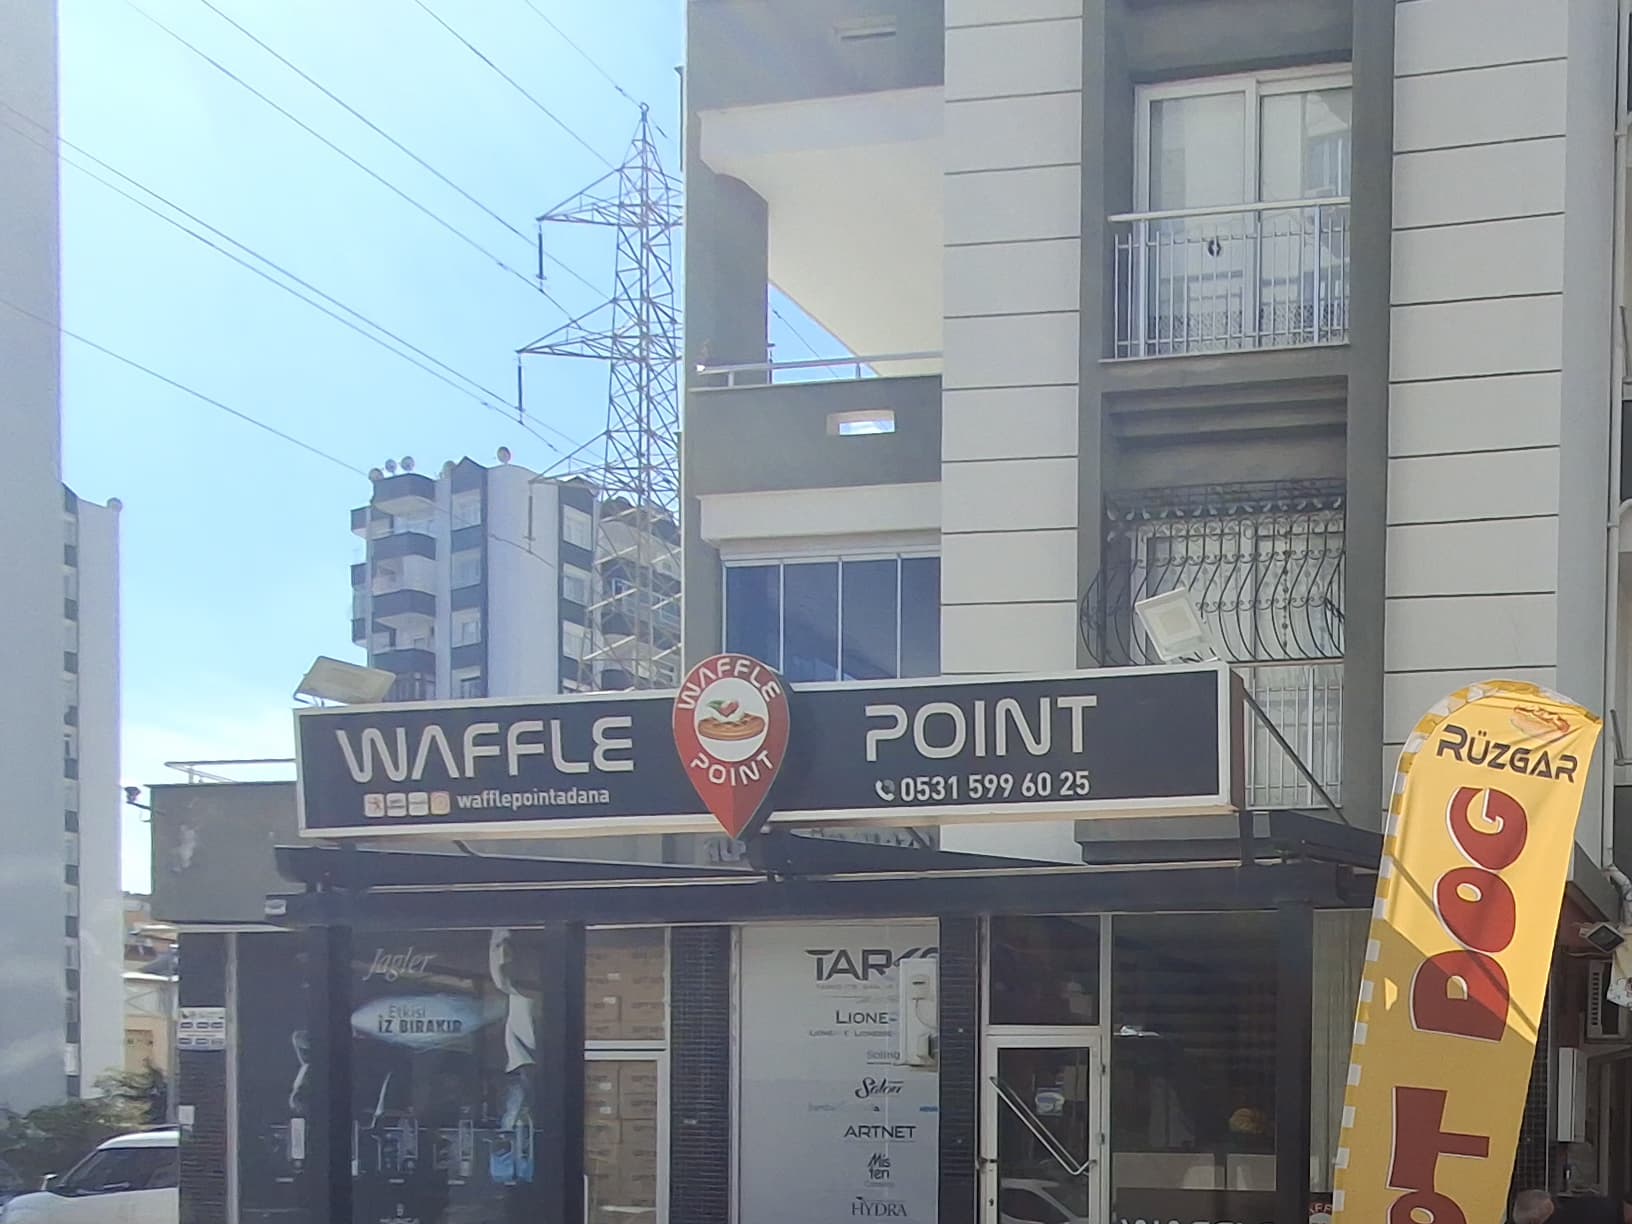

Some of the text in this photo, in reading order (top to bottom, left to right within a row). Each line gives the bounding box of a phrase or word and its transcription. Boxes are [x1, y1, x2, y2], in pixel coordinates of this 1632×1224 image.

[678, 657, 781, 711] WAFFLE
[336, 715, 635, 783] WAFFLE
[865, 695, 1098, 762] POINT
[690, 750, 774, 786] POINT
[1436, 723, 1579, 784] RÜZGAR
[457, 787, 611, 811] wafflepointadana
[901, 770, 1090, 802] 0531 599 60 25
[1408, 785, 1529, 1044] DOG
[843, 1125, 918, 1139] ARTNET
[851, 1201, 908, 1217] HYDRA
